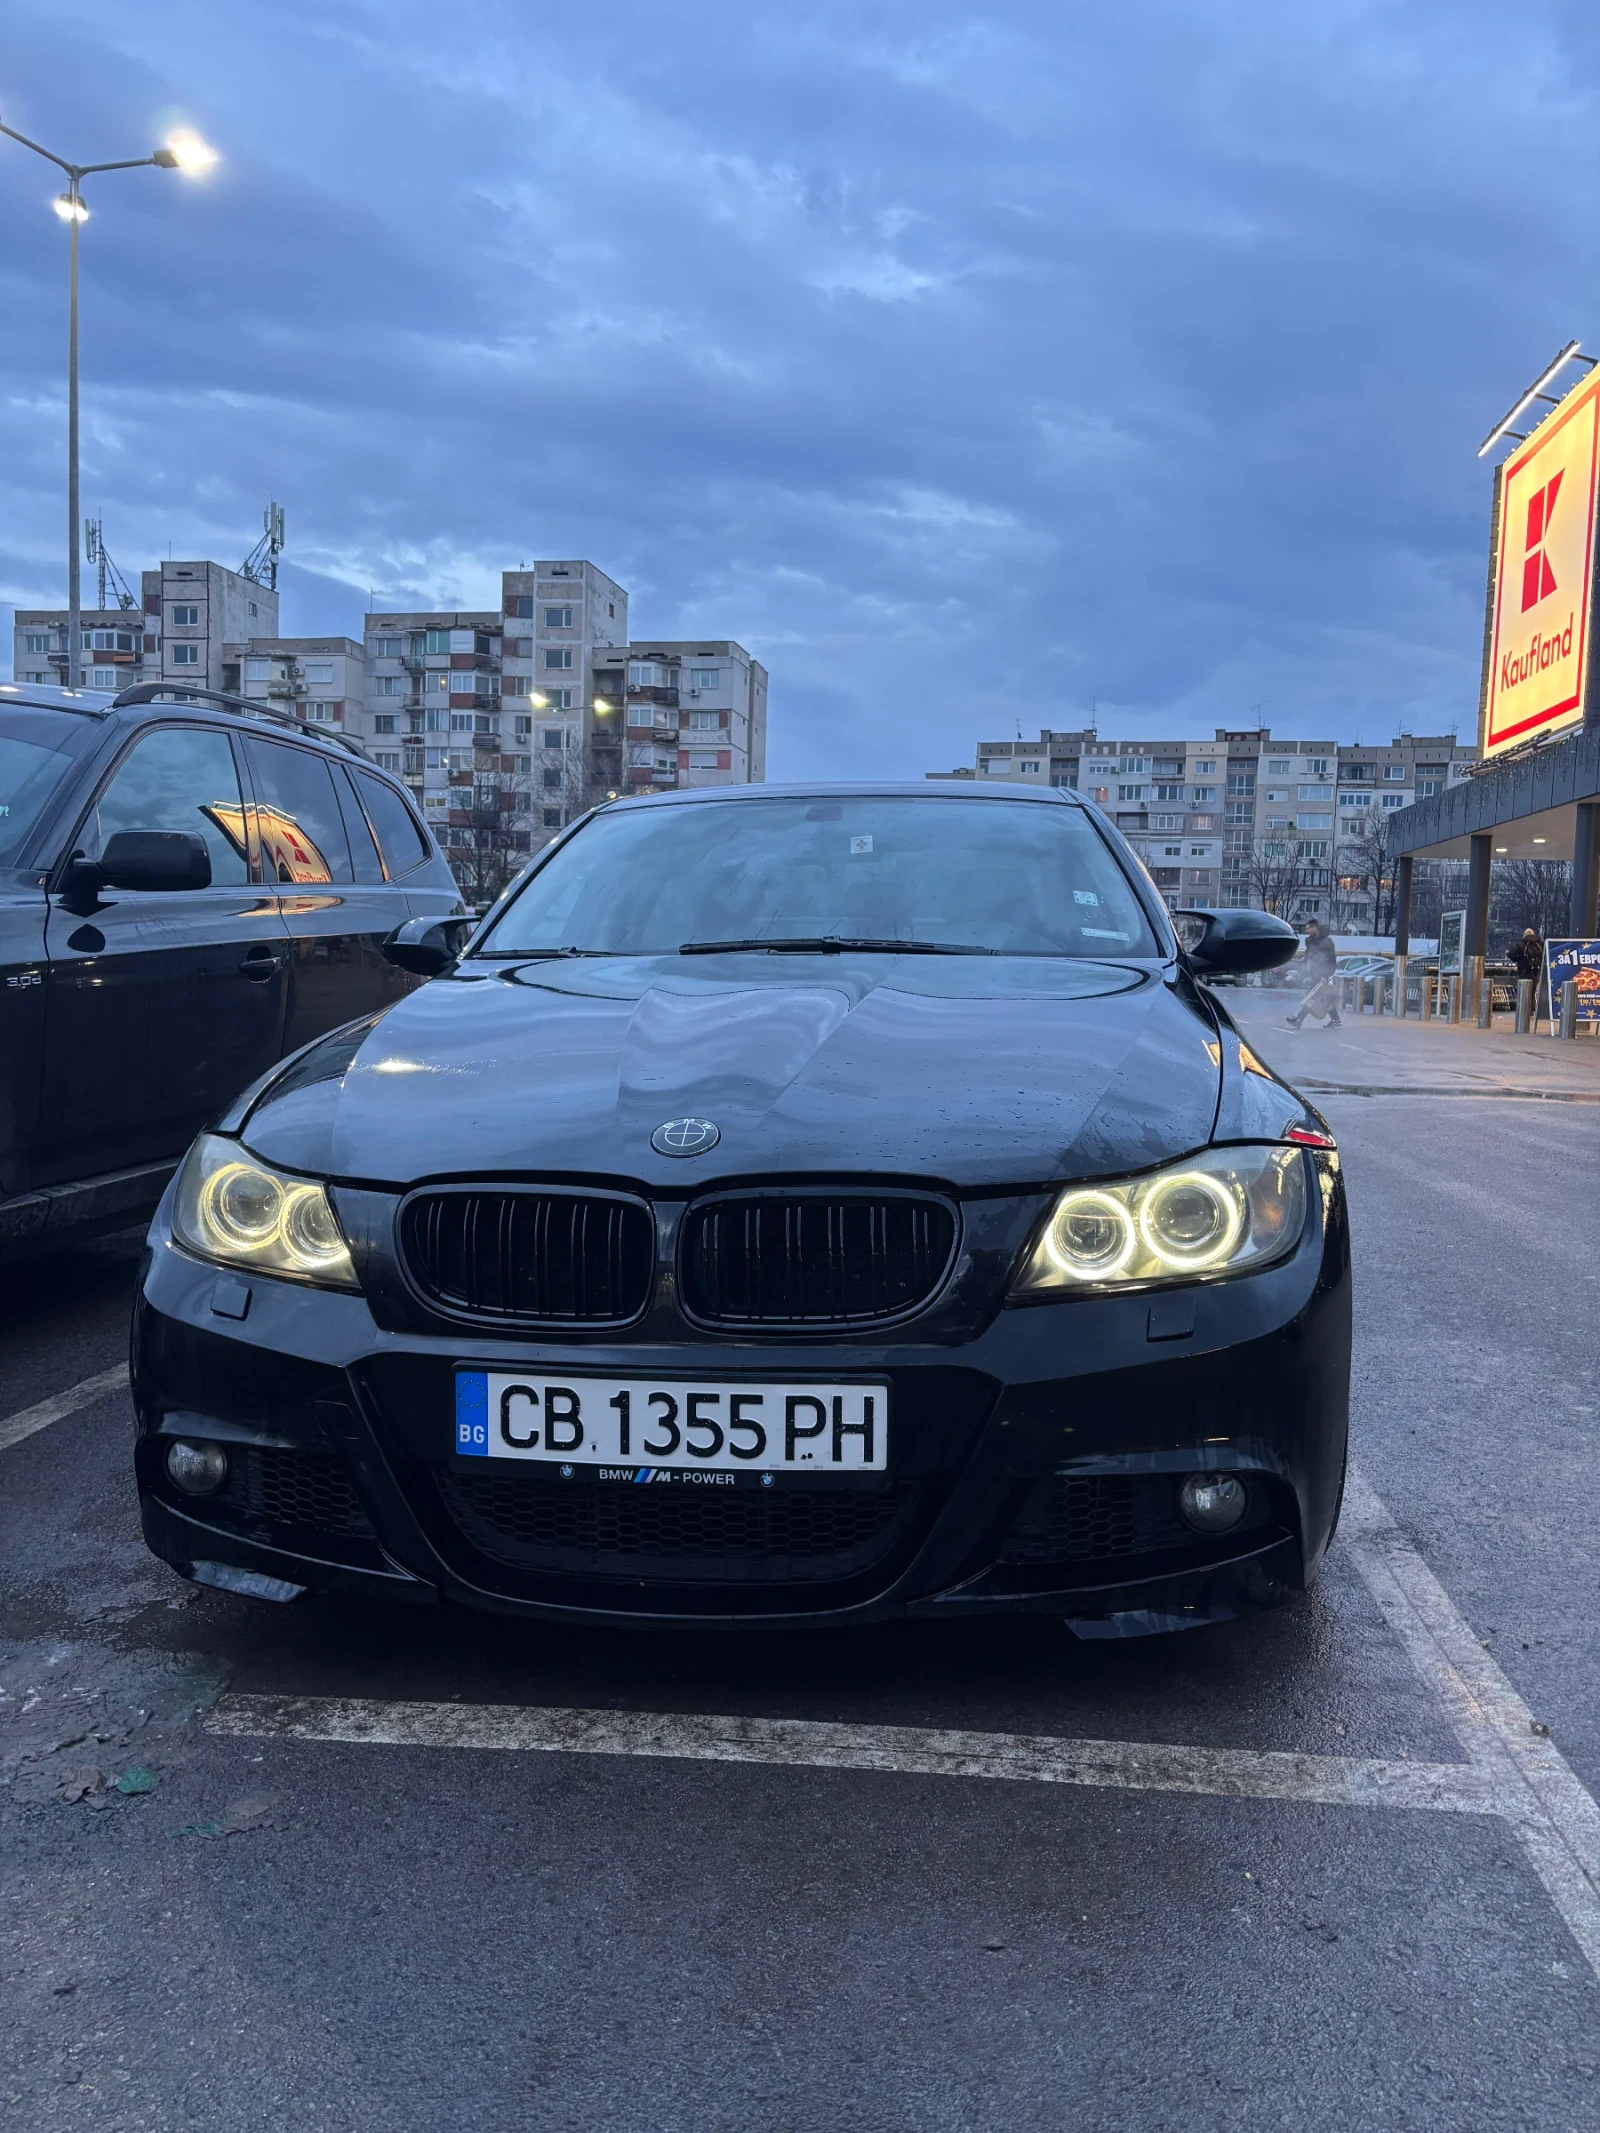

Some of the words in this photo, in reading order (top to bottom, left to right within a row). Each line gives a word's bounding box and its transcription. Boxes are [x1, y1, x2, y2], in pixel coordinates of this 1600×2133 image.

[1500, 611, 1574, 693] Kaufland
[1557, 954, 1571, 965] ЗА
[1570, 950, 1579, 966] 1
[6, 975, 42, 987] 3.0d
[662, 1118, 714, 1130] BMW
[500, 1384, 584, 1451] CB
[609, 1390, 767, 1460] 1355
[784, 1395, 874, 1463] PH
[459, 1423, 485, 1444] BG
[599, 1468, 634, 1481] BMW
